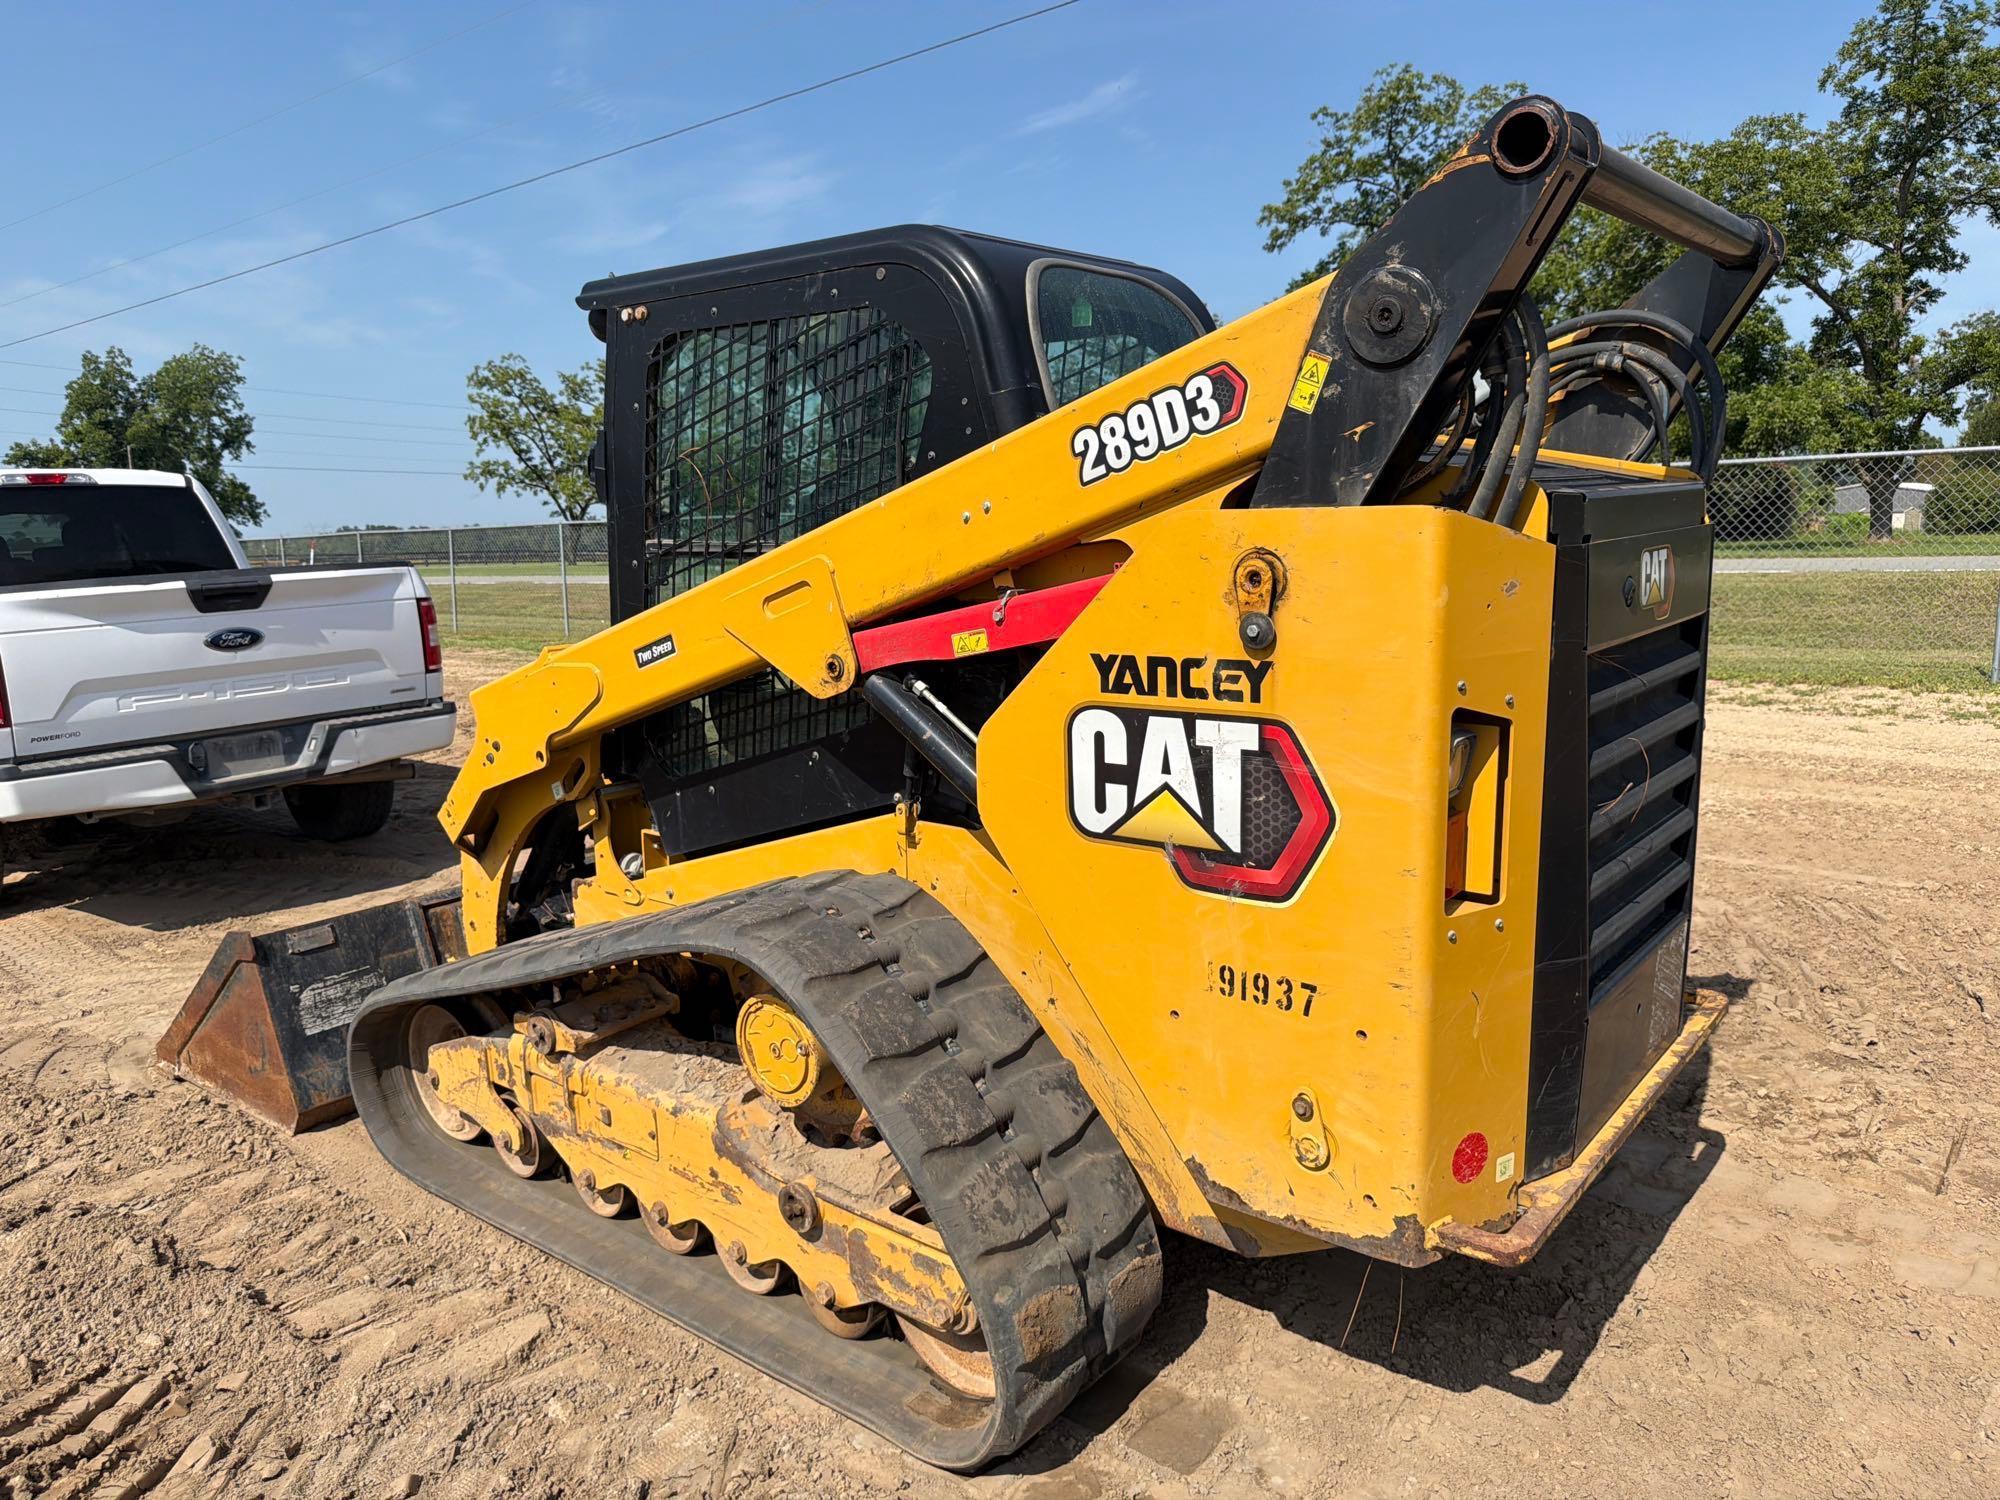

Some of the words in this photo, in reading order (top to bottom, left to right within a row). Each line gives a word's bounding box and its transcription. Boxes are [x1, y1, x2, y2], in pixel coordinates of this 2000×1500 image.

[1073, 374, 1221, 483] 289D3
[1640, 548, 1668, 606] CAT
[1089, 653, 1276, 704] YANCEY
[1071, 708, 1260, 854] CAT
[1218, 964, 1318, 1018] 91937
